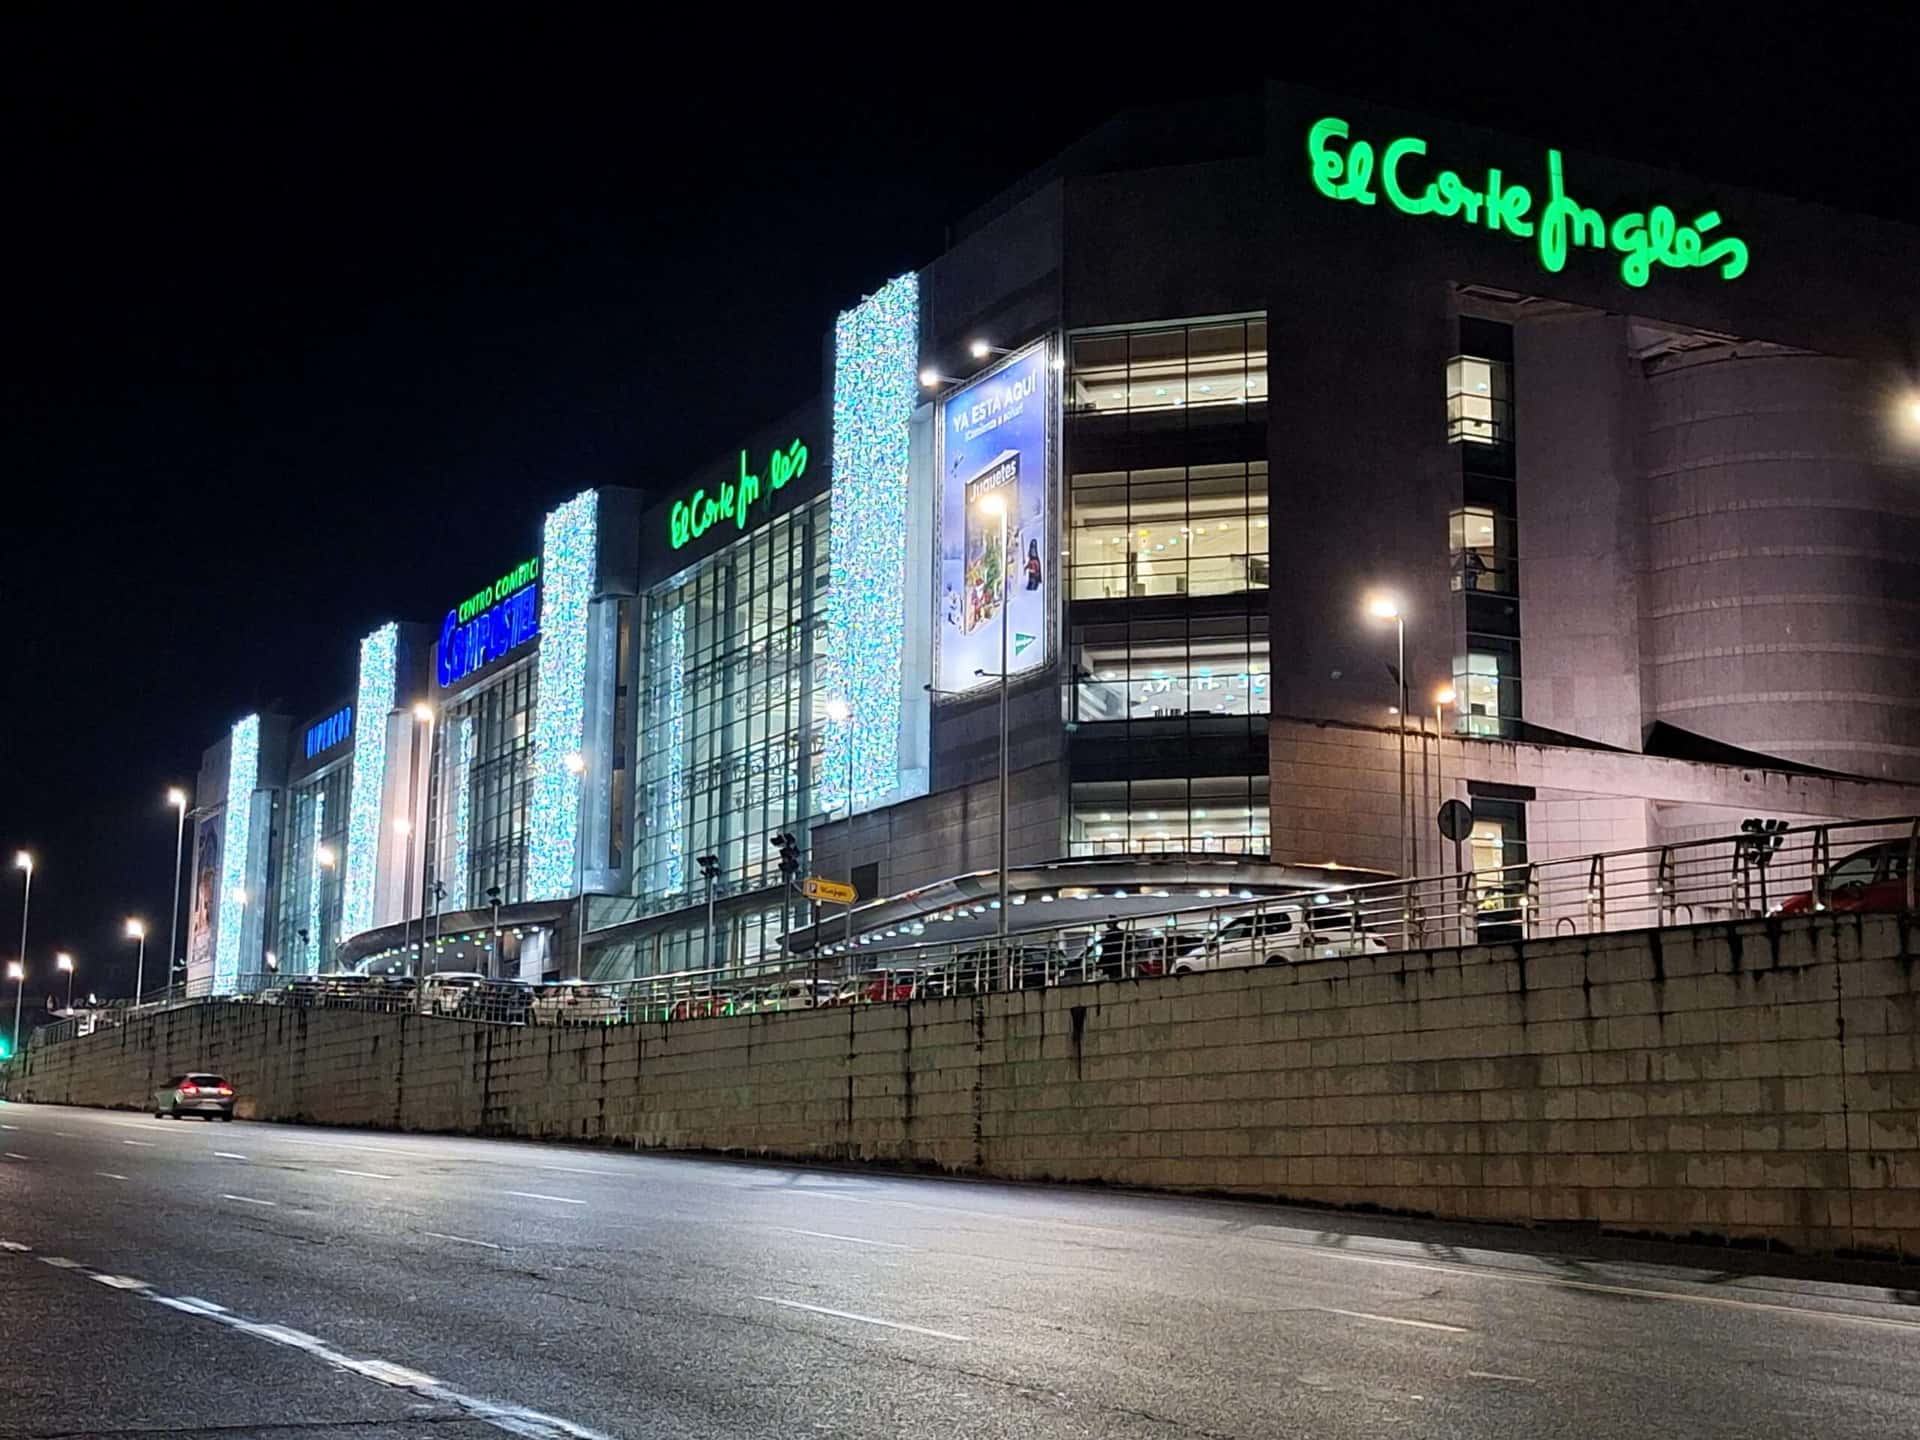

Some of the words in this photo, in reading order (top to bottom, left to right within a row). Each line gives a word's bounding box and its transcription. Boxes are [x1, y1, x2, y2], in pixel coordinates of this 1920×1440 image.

[1309, 117, 1376, 205] El
[1382, 137, 1534, 237] Corte
[1539, 148, 1749, 288] Inglés
[953, 411, 969, 433] YA
[671, 500, 690, 550] El
[691, 489, 735, 538] Corte
[736, 437, 808, 530] Inlés
[458, 585, 493, 623] CENTRO
[495, 557, 539, 601] COMERCI
